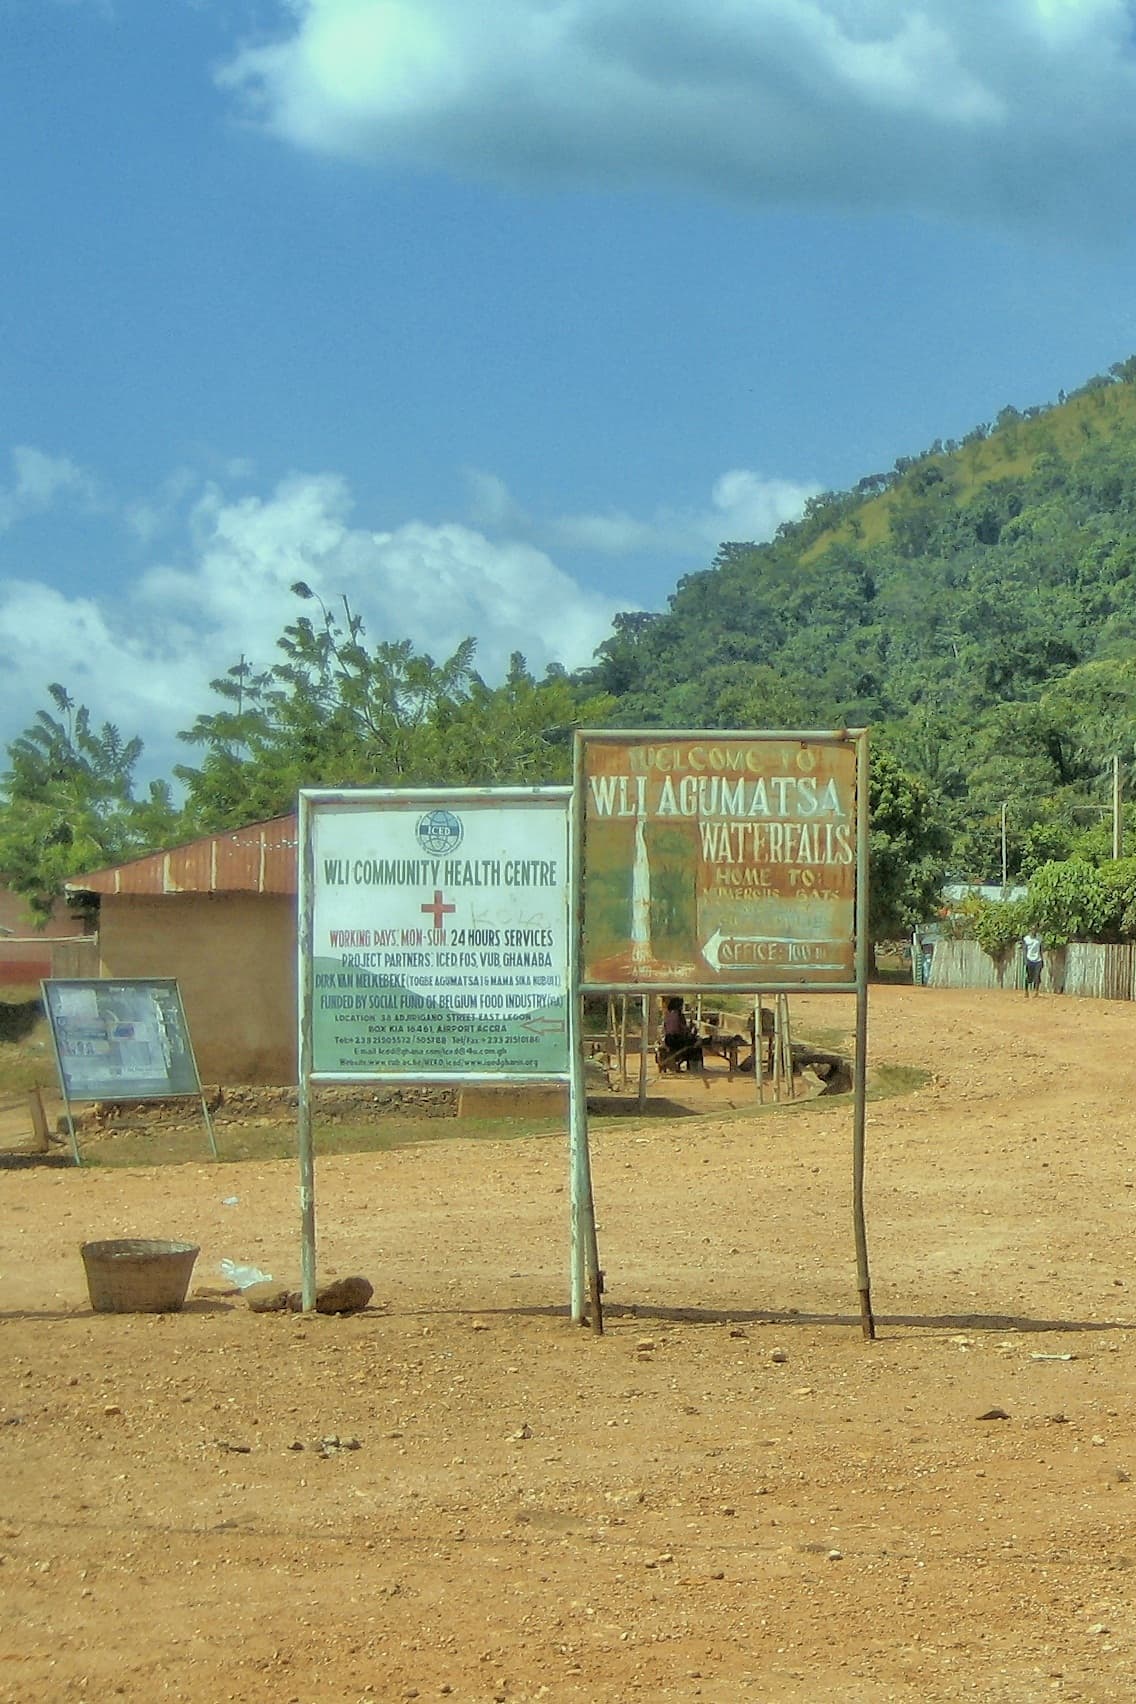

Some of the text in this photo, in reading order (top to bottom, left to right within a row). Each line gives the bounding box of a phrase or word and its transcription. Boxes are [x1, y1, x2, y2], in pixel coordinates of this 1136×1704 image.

[781, 748, 816, 772] TO
[590, 775, 846, 817] WLI AGUMATSA
[428, 825, 450, 836] ICED
[699, 822, 853, 865] WATERFALLS
[324, 860, 557, 886] WLI COMMUNITY HEALTH CENTRE
[716, 867, 772, 886] HOME
[330, 929, 371, 947] WORKING
[451, 929, 465, 947] 24
[468, 929, 500, 947] HOURS
[504, 929, 553, 947] SERVICES
[342, 953, 381, 968] PROJECT
[503, 952, 552, 967] GHANABA
[316, 974, 336, 989] DIRK
[338, 974, 353, 989] VAN
[321, 994, 353, 1009] FUNDED
[355, 994, 367, 1009] BY
[369, 994, 398, 1009] SOCIAL
[401, 994, 424, 1009] FUND
[426, 994, 438, 1009] OF
[440, 994, 478, 1009] BELGIUM
[480, 994, 503, 1009] FOOD
[506, 994, 547, 1008] INDUSTRY
